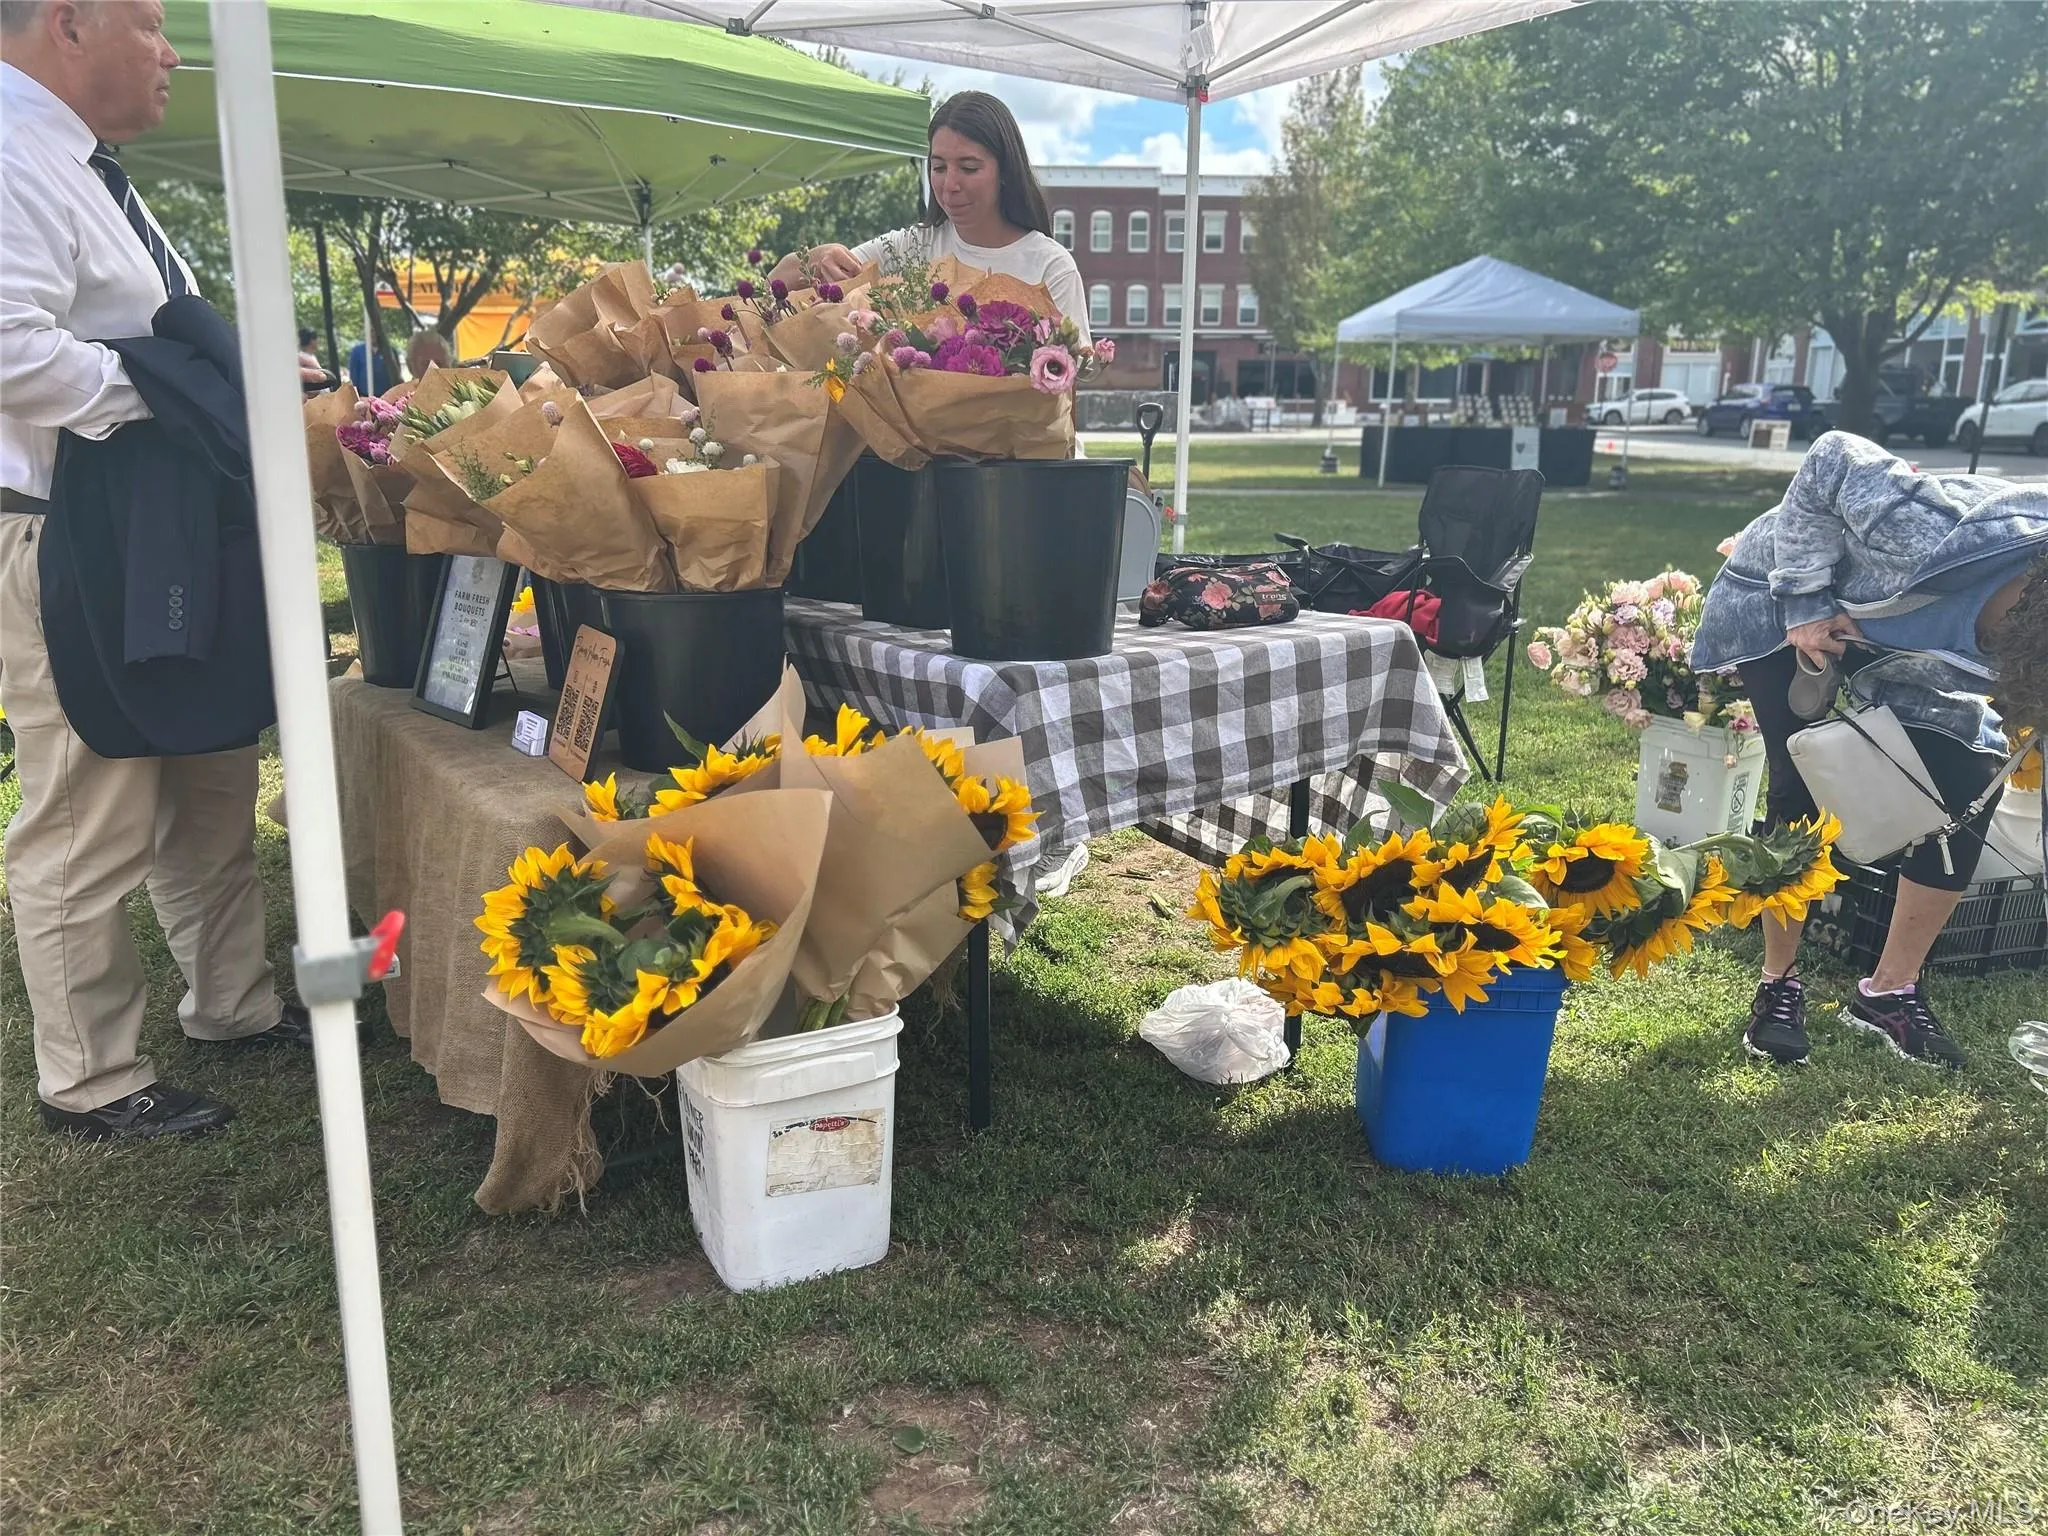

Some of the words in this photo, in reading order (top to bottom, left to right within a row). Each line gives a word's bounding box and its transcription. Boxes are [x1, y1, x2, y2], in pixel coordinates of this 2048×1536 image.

[454, 591, 470, 600] FARM
[471, 594, 490, 605] FRESH
[454, 602, 485, 616] BOUQUETS
